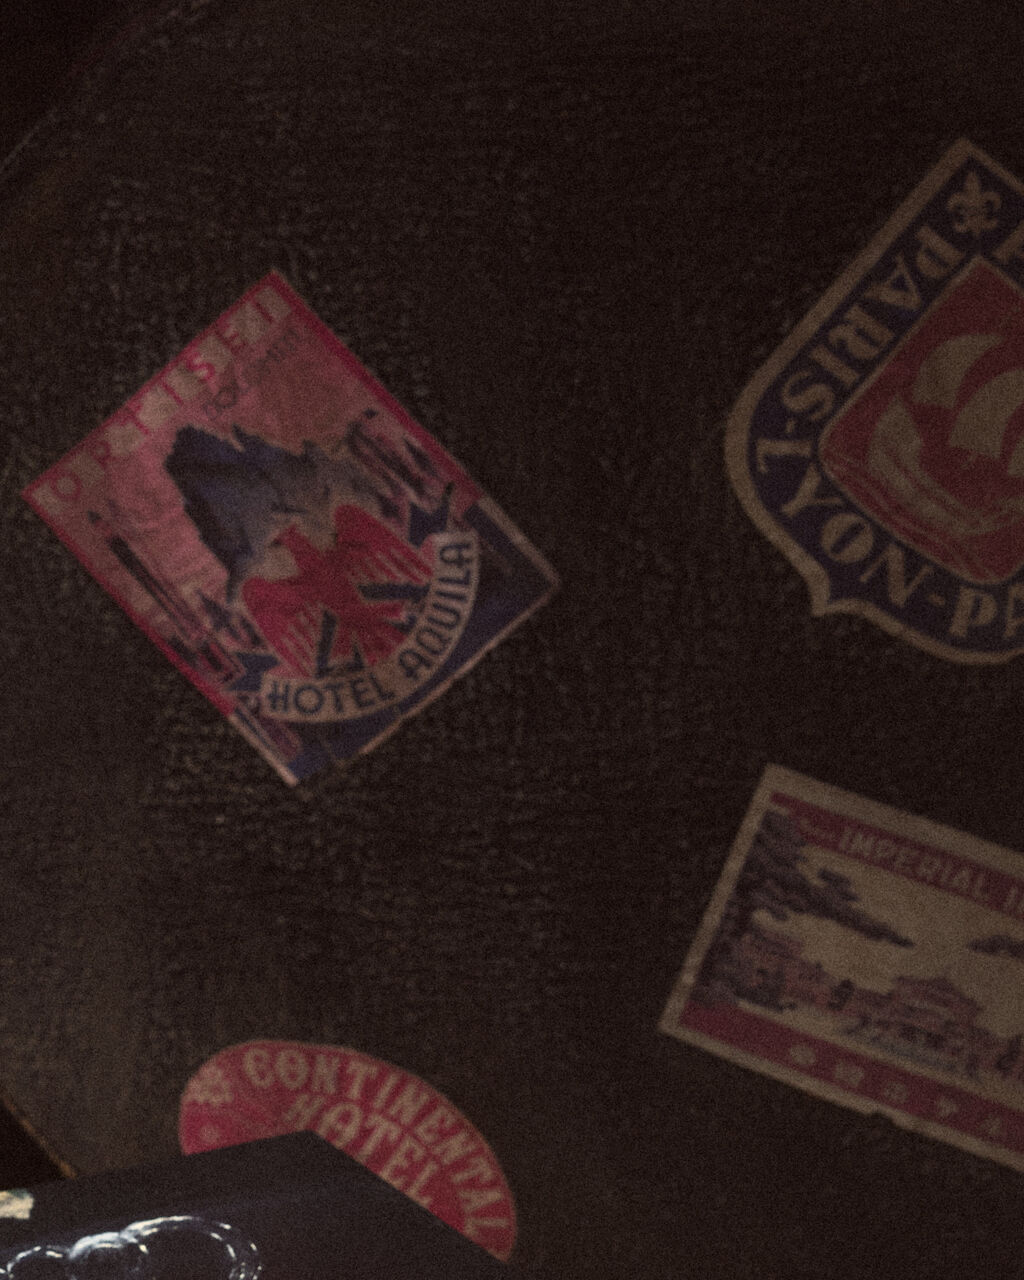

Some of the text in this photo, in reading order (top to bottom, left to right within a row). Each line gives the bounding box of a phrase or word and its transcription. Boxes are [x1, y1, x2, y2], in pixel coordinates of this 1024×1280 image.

[49, 301, 279, 505] ORTISEI
[267, 541, 472, 715] HOTEL AQUILA
[836, 826, 990, 901] IMPERIAL
[242, 1048, 507, 1235] CONTINENTAL
